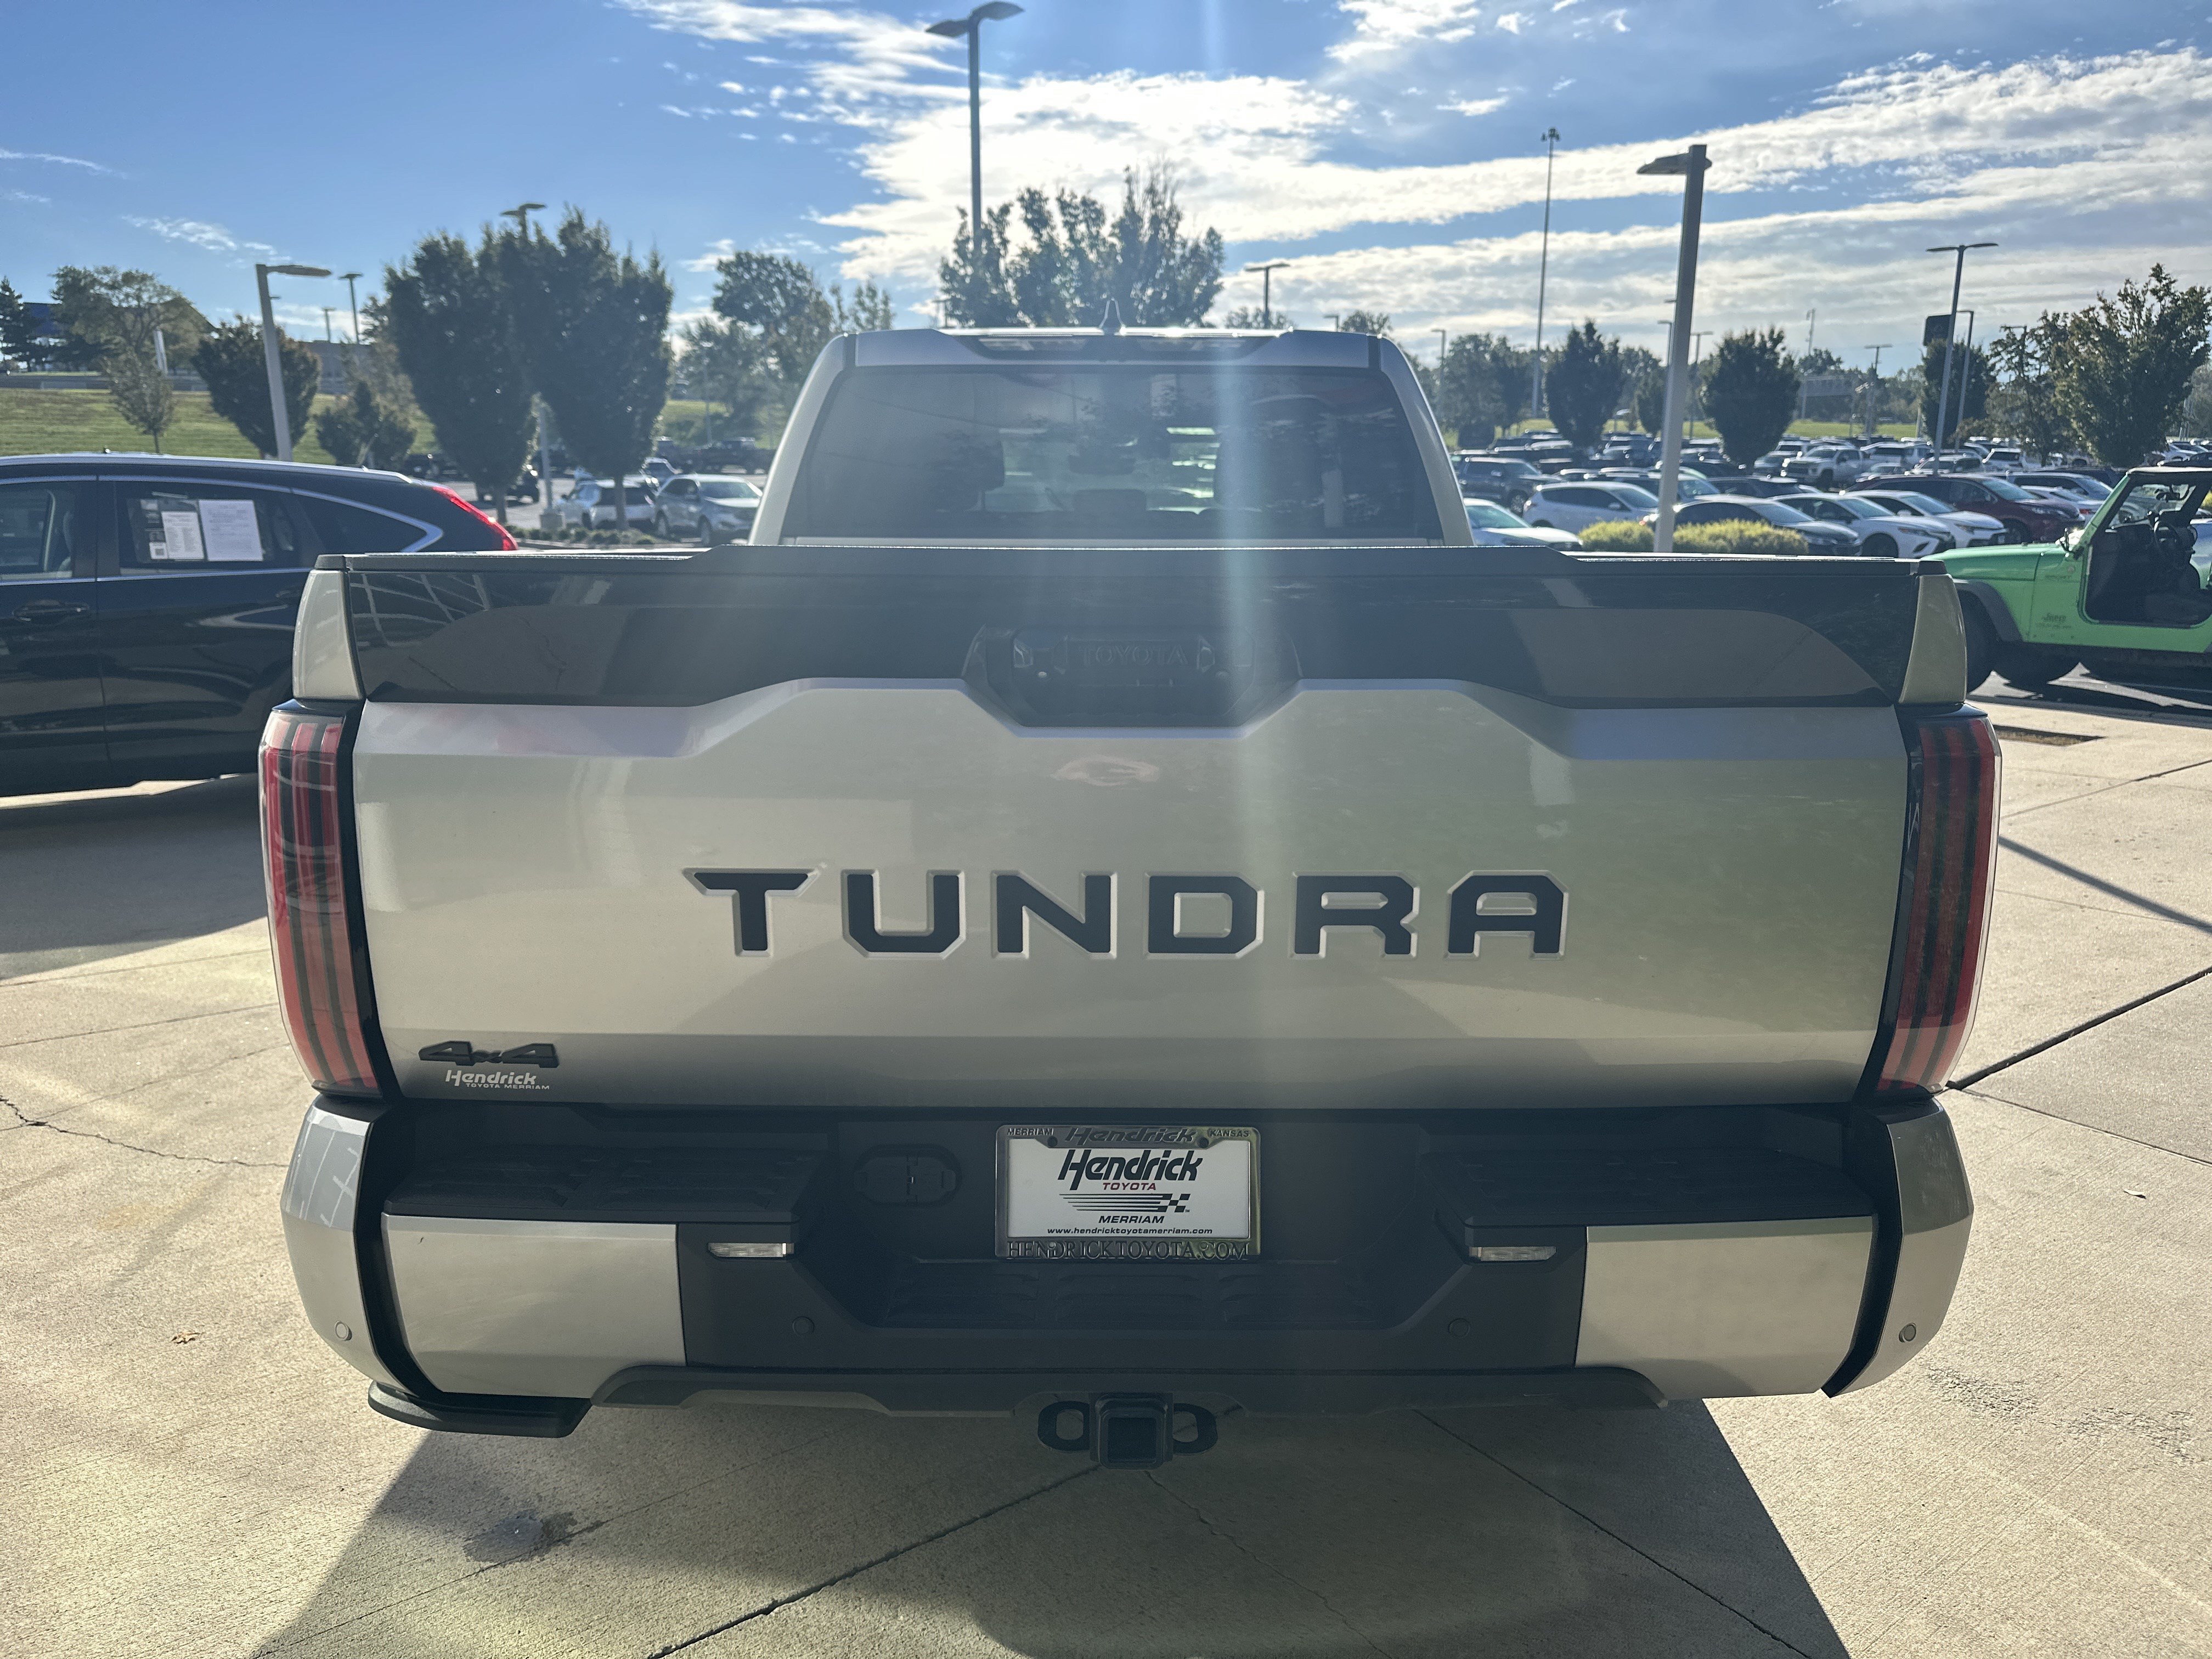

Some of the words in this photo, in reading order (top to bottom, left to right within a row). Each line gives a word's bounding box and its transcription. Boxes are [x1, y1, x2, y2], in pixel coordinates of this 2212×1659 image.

[1079, 644, 1188, 665] TOYOTA
[681, 868, 1568, 960] TUNDRA
[419, 1041, 560, 1068] 4x4
[445, 1070, 537, 1086] Hendrick
[1065, 1127, 1197, 1146] Hendrick
[1210, 1129, 1250, 1138] KANSAS
[1058, 1149, 1203, 1190] Hendrick
[1102, 1182, 1156, 1190] TOYOTA
[1098, 1215, 1164, 1224] MERRIAM
